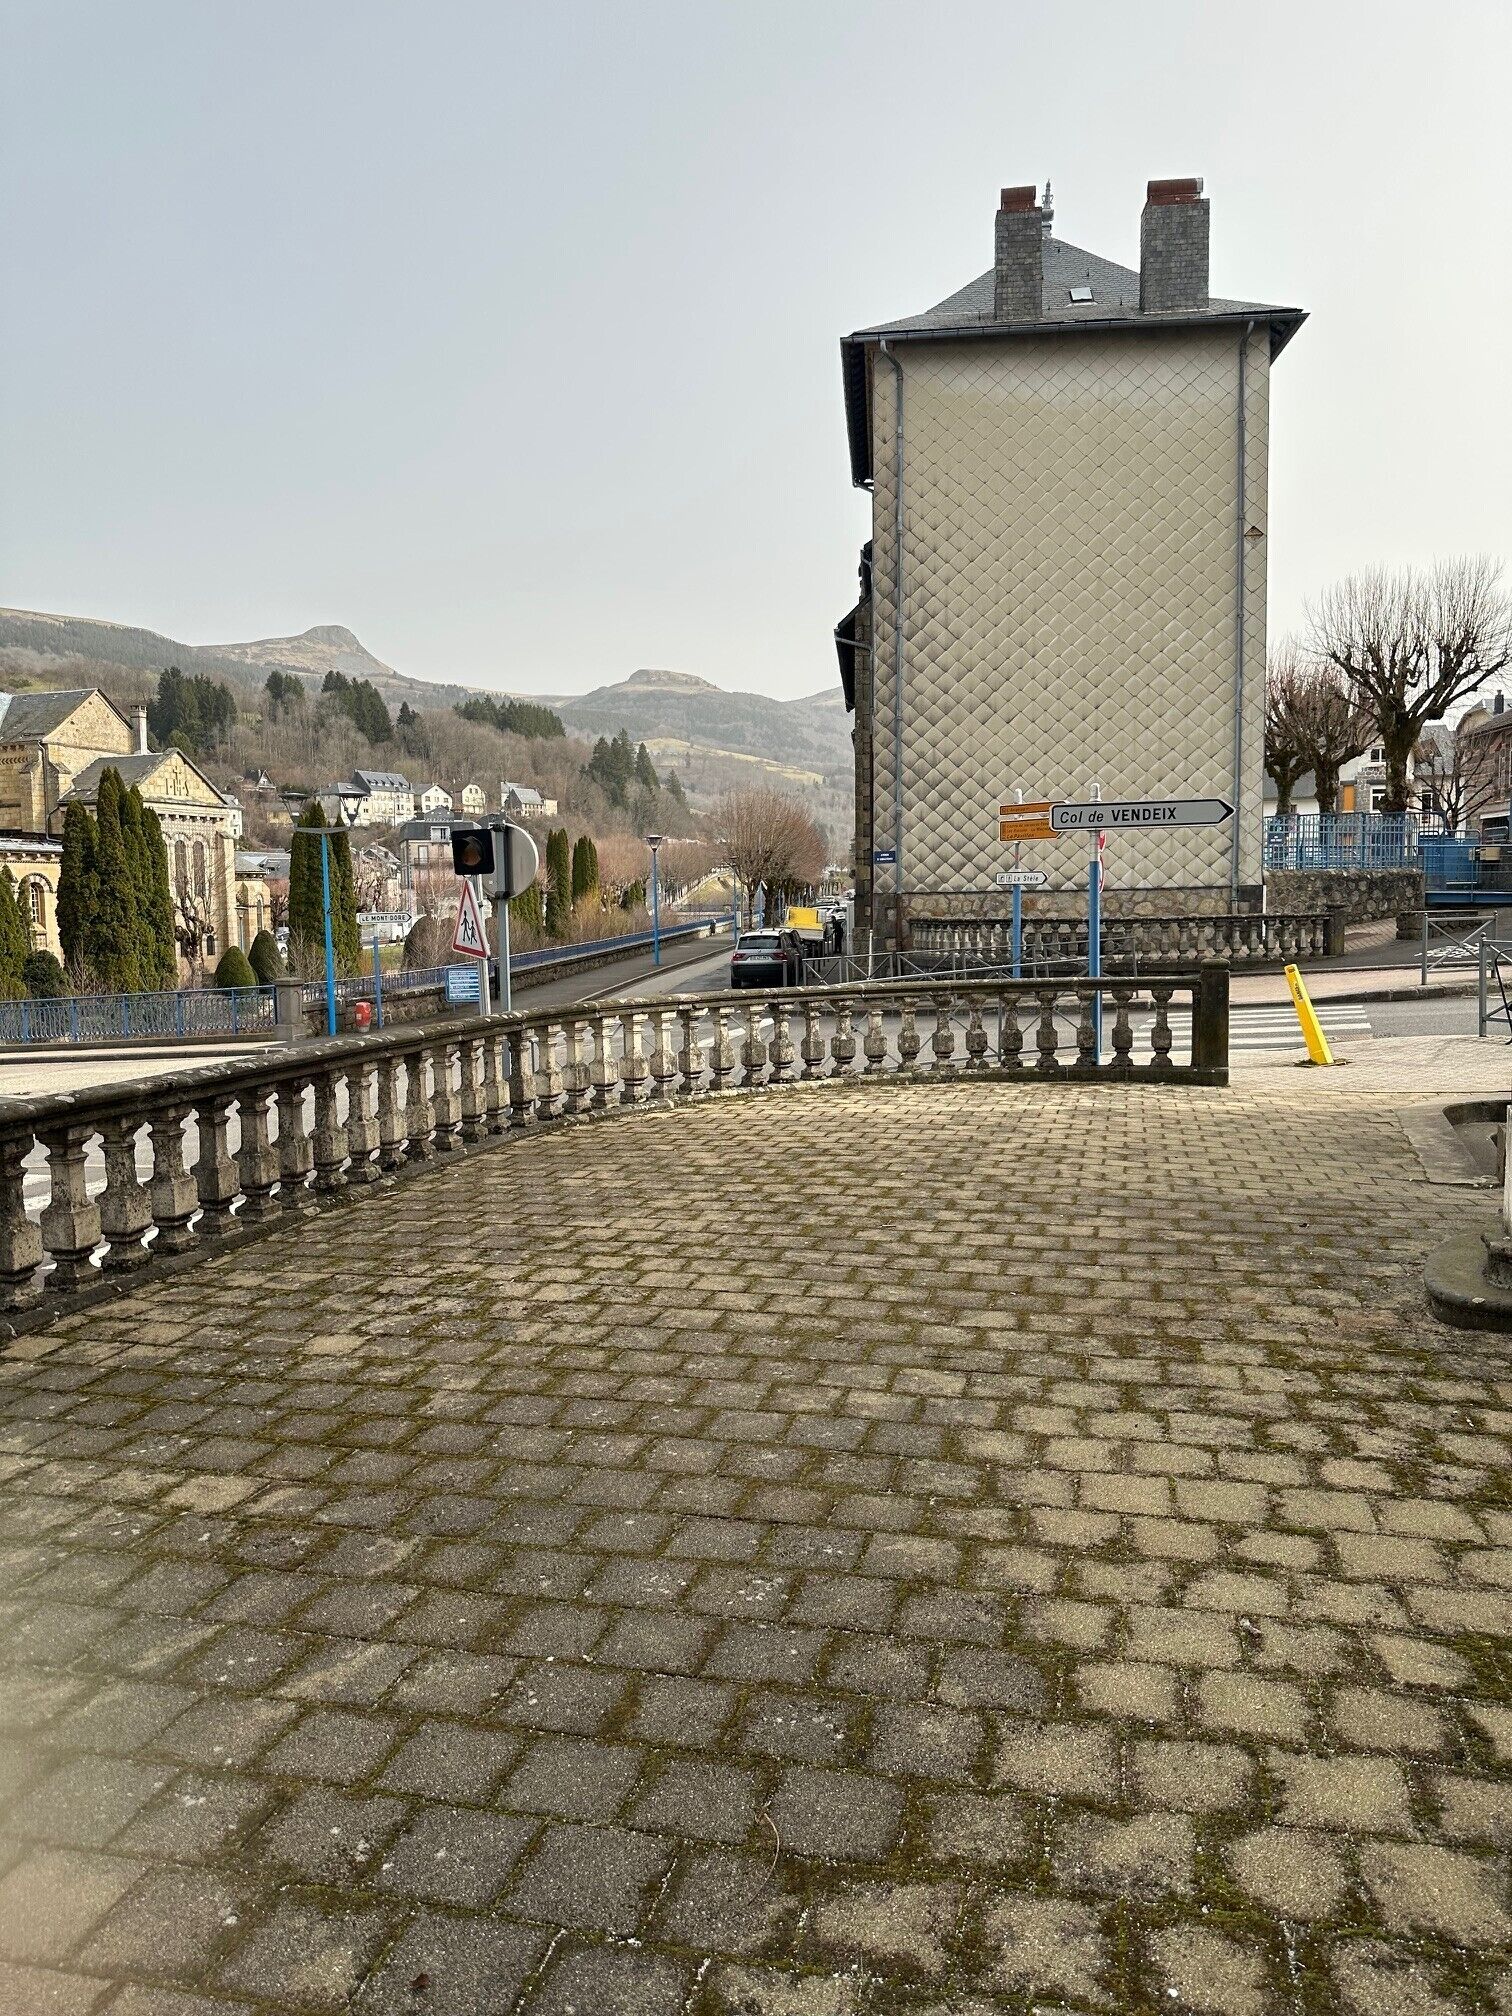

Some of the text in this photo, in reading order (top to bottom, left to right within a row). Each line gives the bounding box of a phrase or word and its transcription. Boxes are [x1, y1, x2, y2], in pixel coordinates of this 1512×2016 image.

[1060, 810, 1083, 824] Col
[1088, 810, 1104, 823] de
[1111, 807, 1177, 822] VENDEIX
